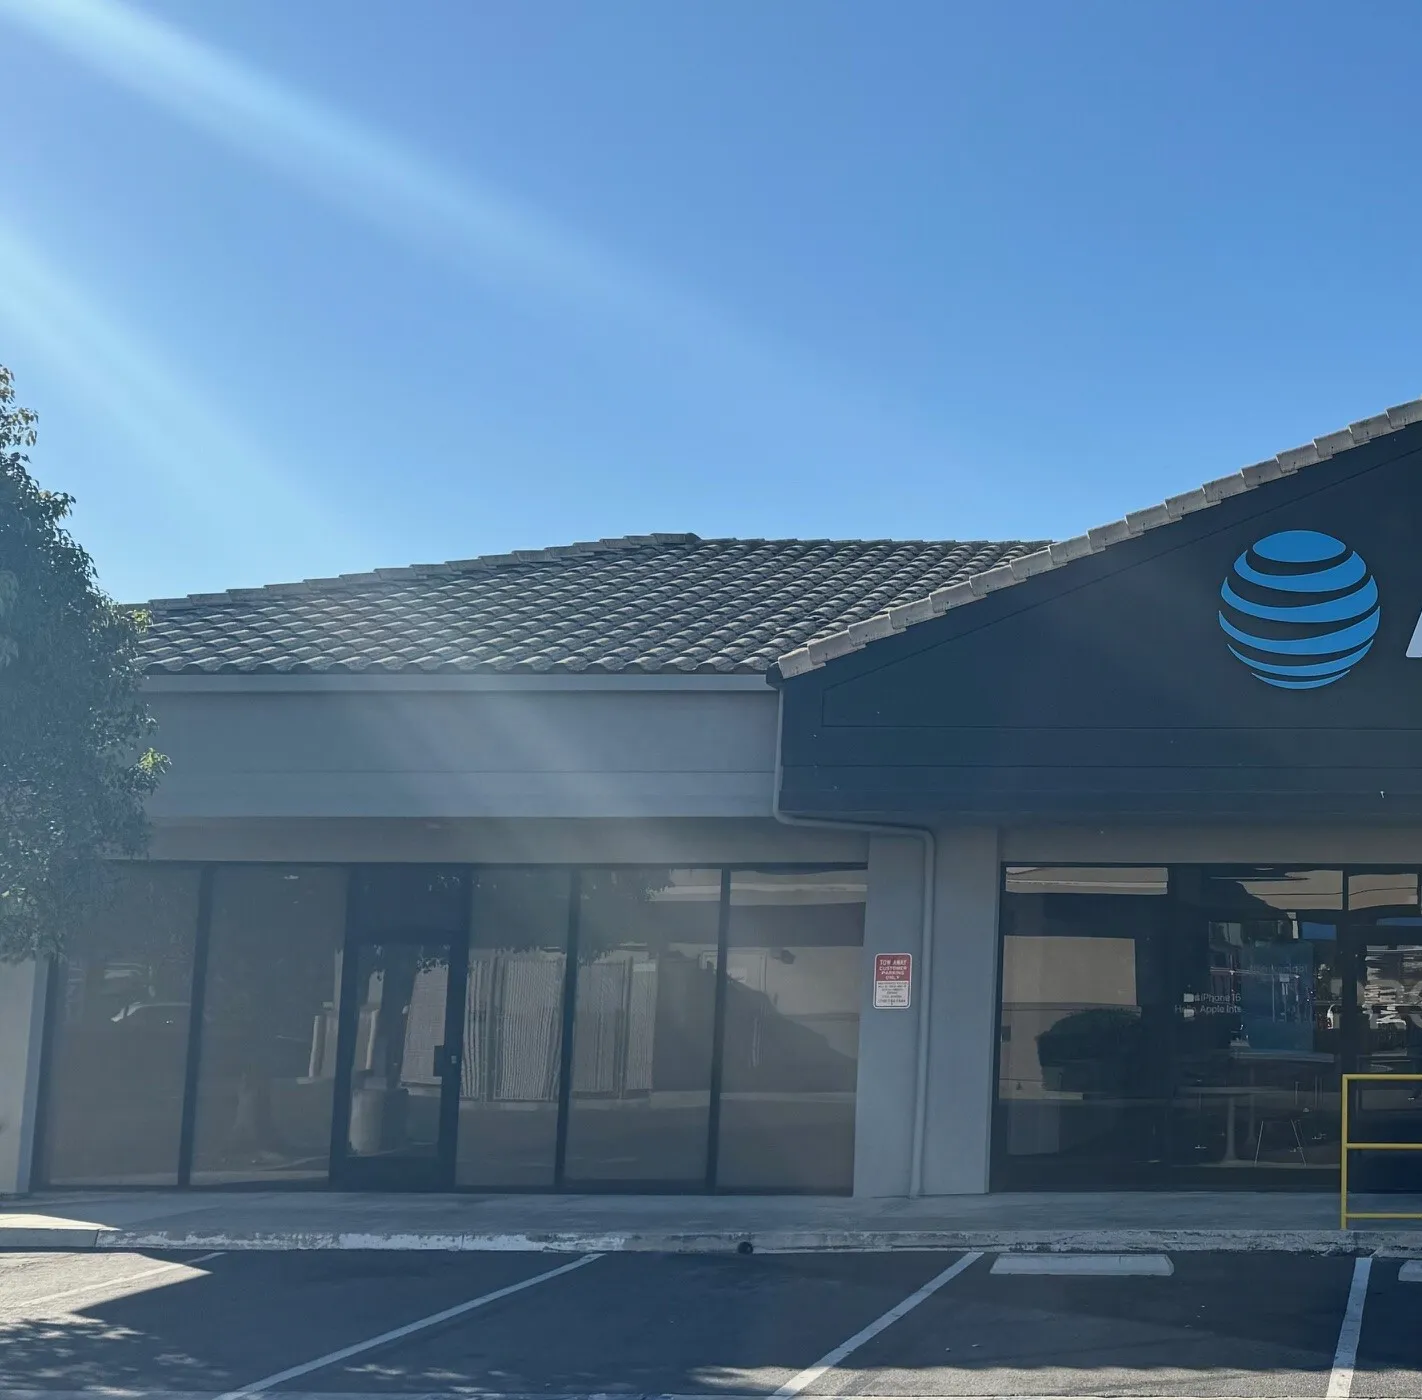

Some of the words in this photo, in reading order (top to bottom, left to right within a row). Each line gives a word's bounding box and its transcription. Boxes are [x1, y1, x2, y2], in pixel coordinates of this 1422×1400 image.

[1201, 993, 1230, 1003] iPhone
[1231, 993, 1242, 1002] 16
[1200, 1005, 1224, 1016] Apple
